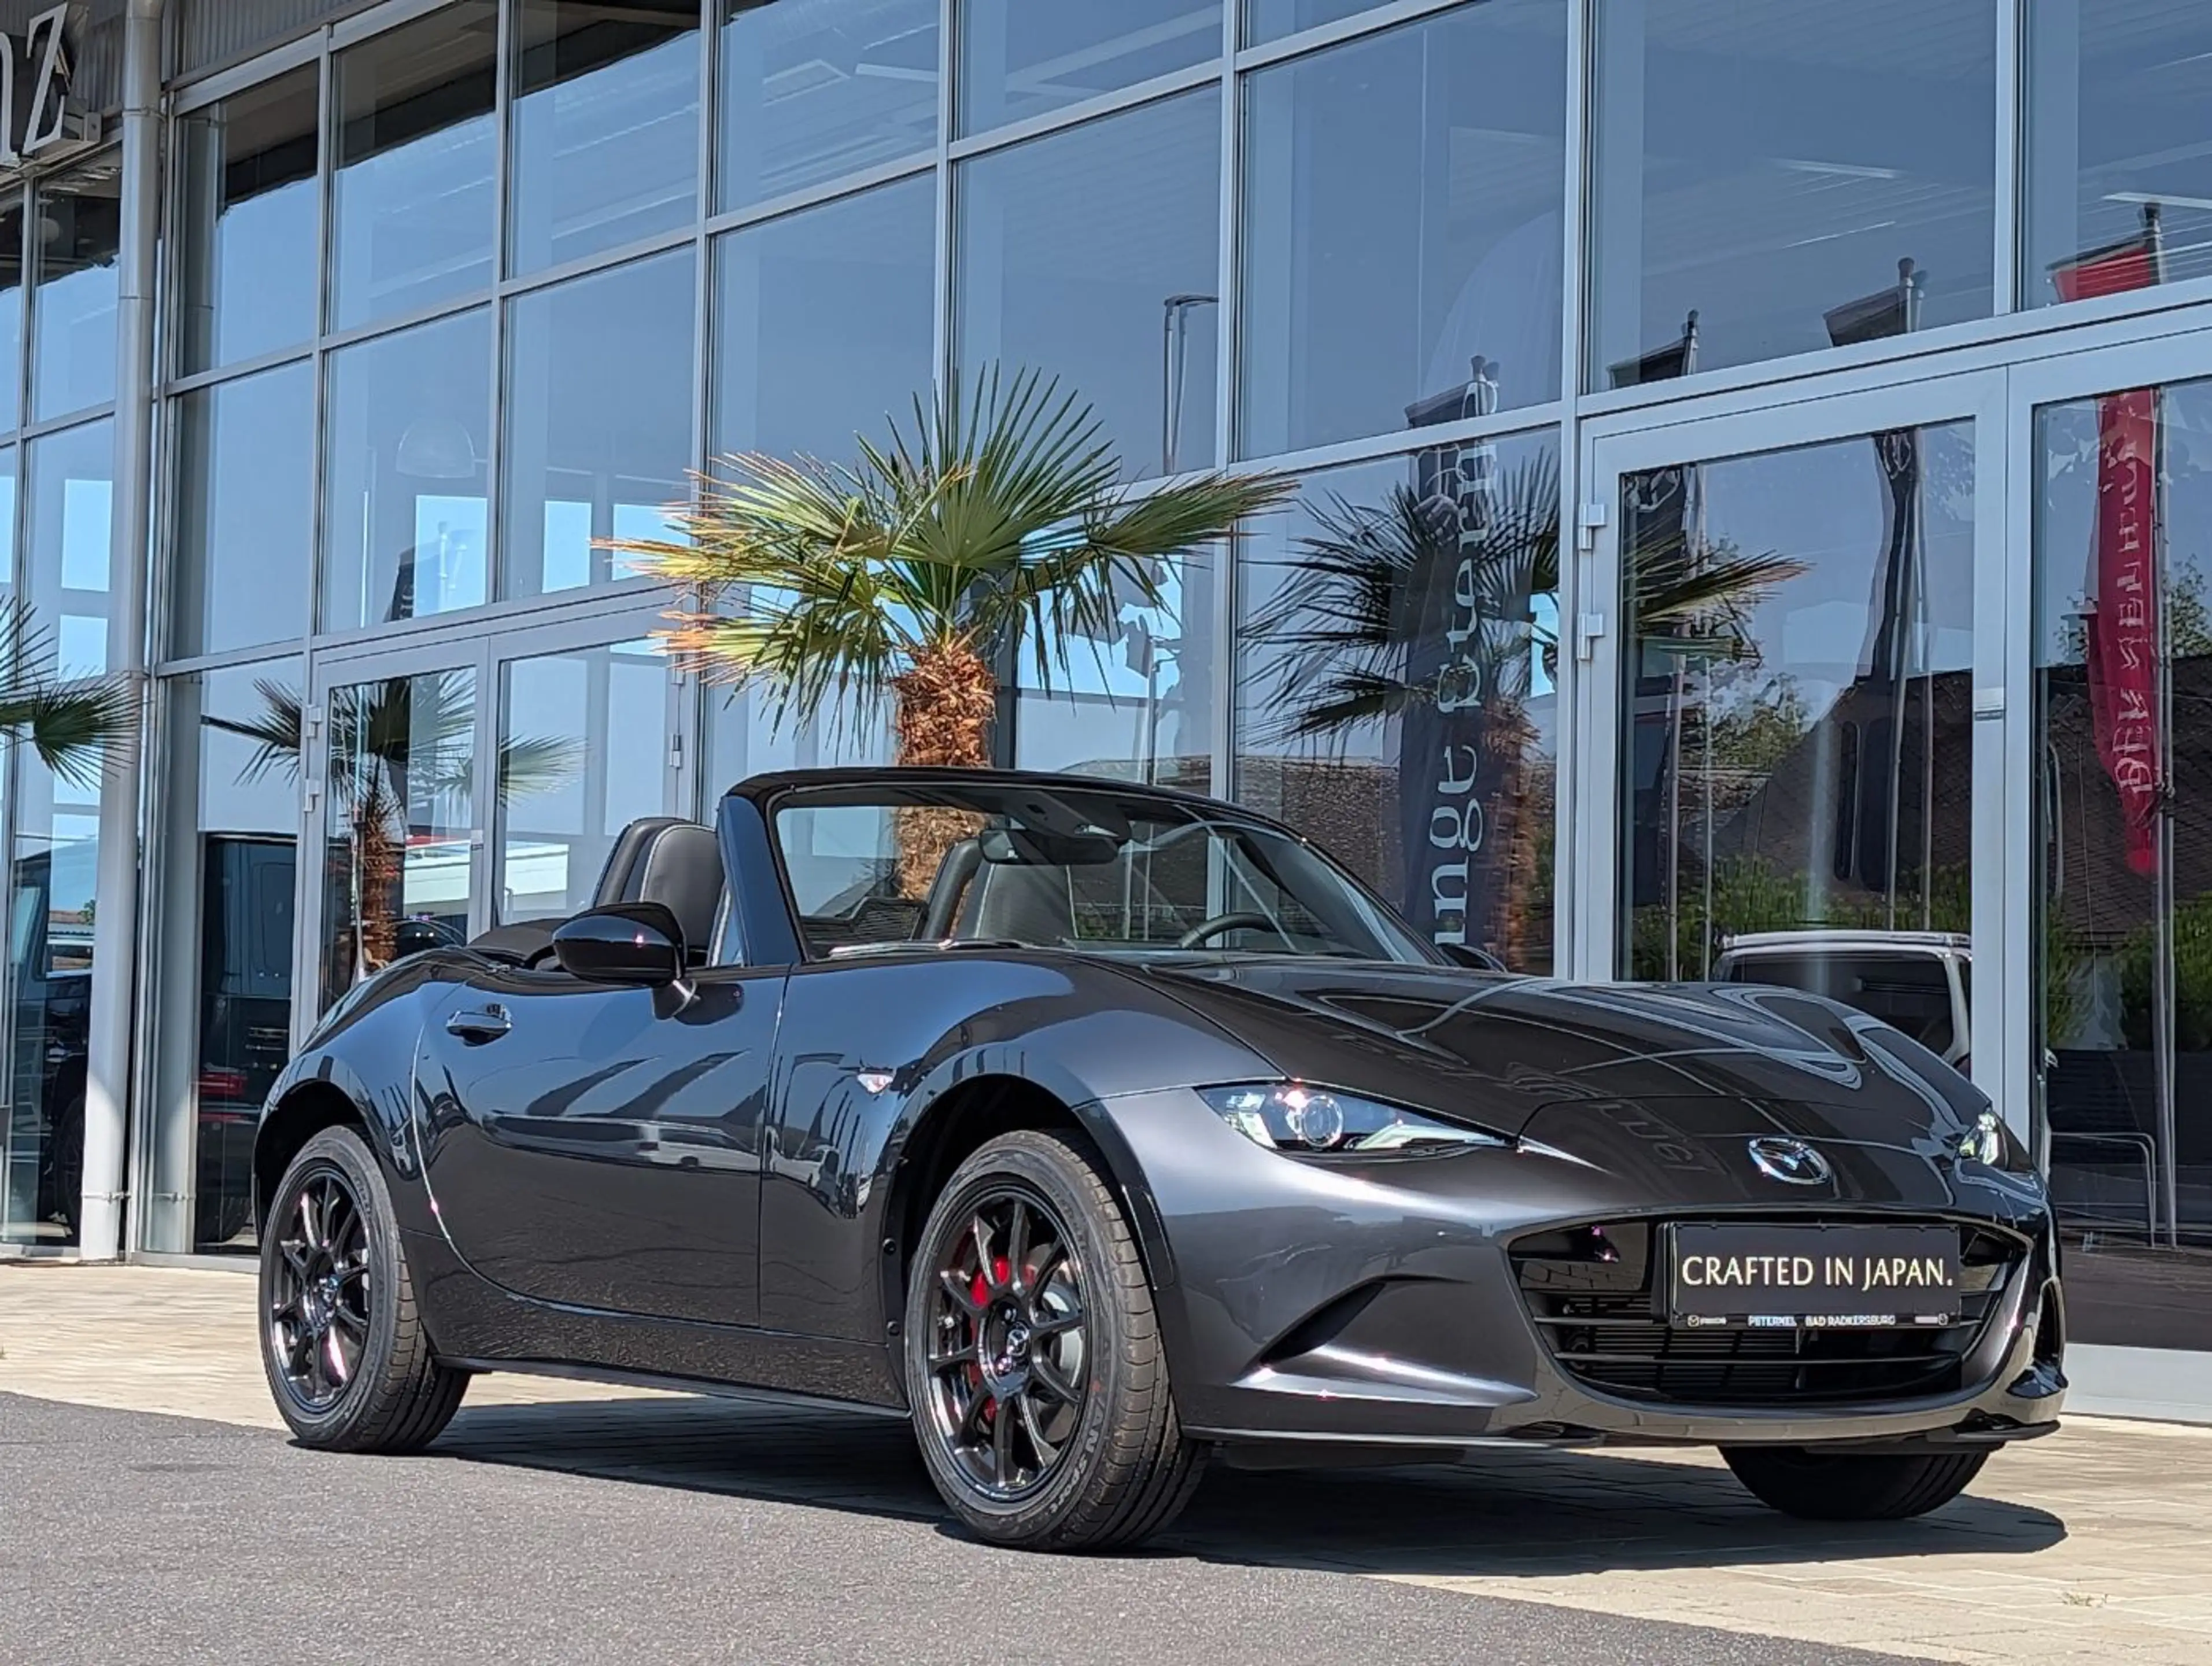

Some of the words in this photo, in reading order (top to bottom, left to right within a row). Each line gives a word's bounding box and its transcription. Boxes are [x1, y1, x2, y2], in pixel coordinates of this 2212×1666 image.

[1682, 1256, 1814, 1286] CRAFTED
[1825, 1256, 1853, 1286] IN
[1861, 1256, 1954, 1292] JAPAN.
[1804, 1315, 1826, 1327] BAD
